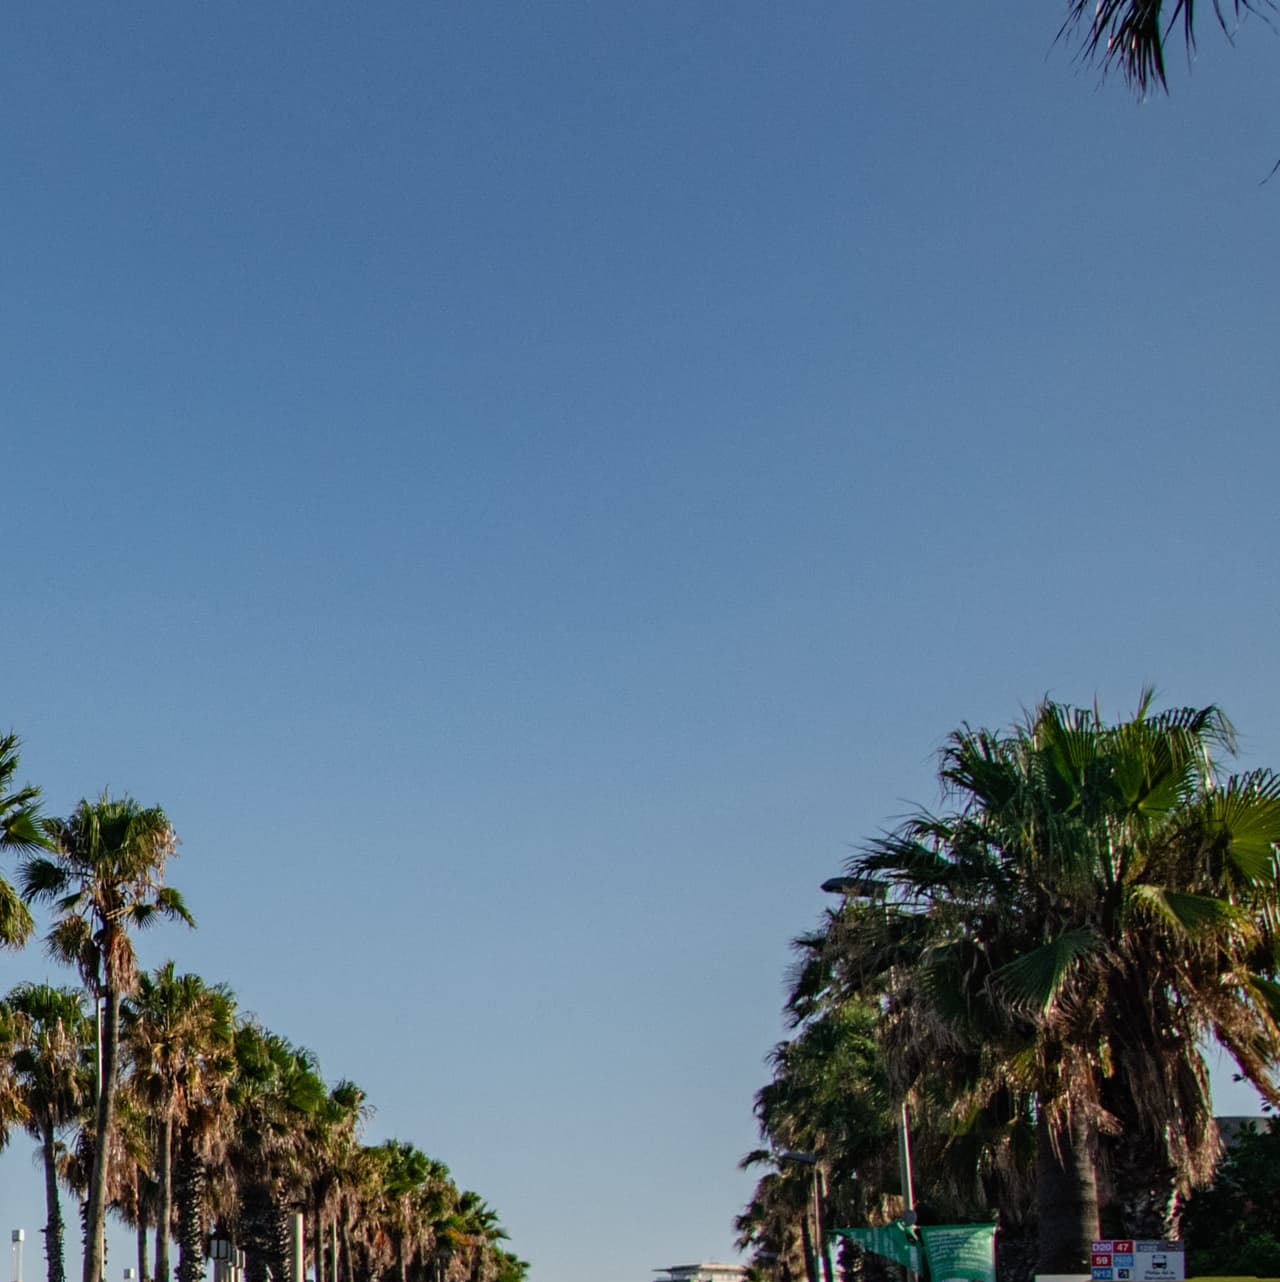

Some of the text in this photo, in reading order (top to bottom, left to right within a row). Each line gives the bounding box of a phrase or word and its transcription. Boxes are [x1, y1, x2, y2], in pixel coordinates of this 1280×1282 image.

[1092, 1243, 1112, 1252] D20
[1116, 1243, 1129, 1252] 47
[1096, 1256, 1108, 1265] 59
